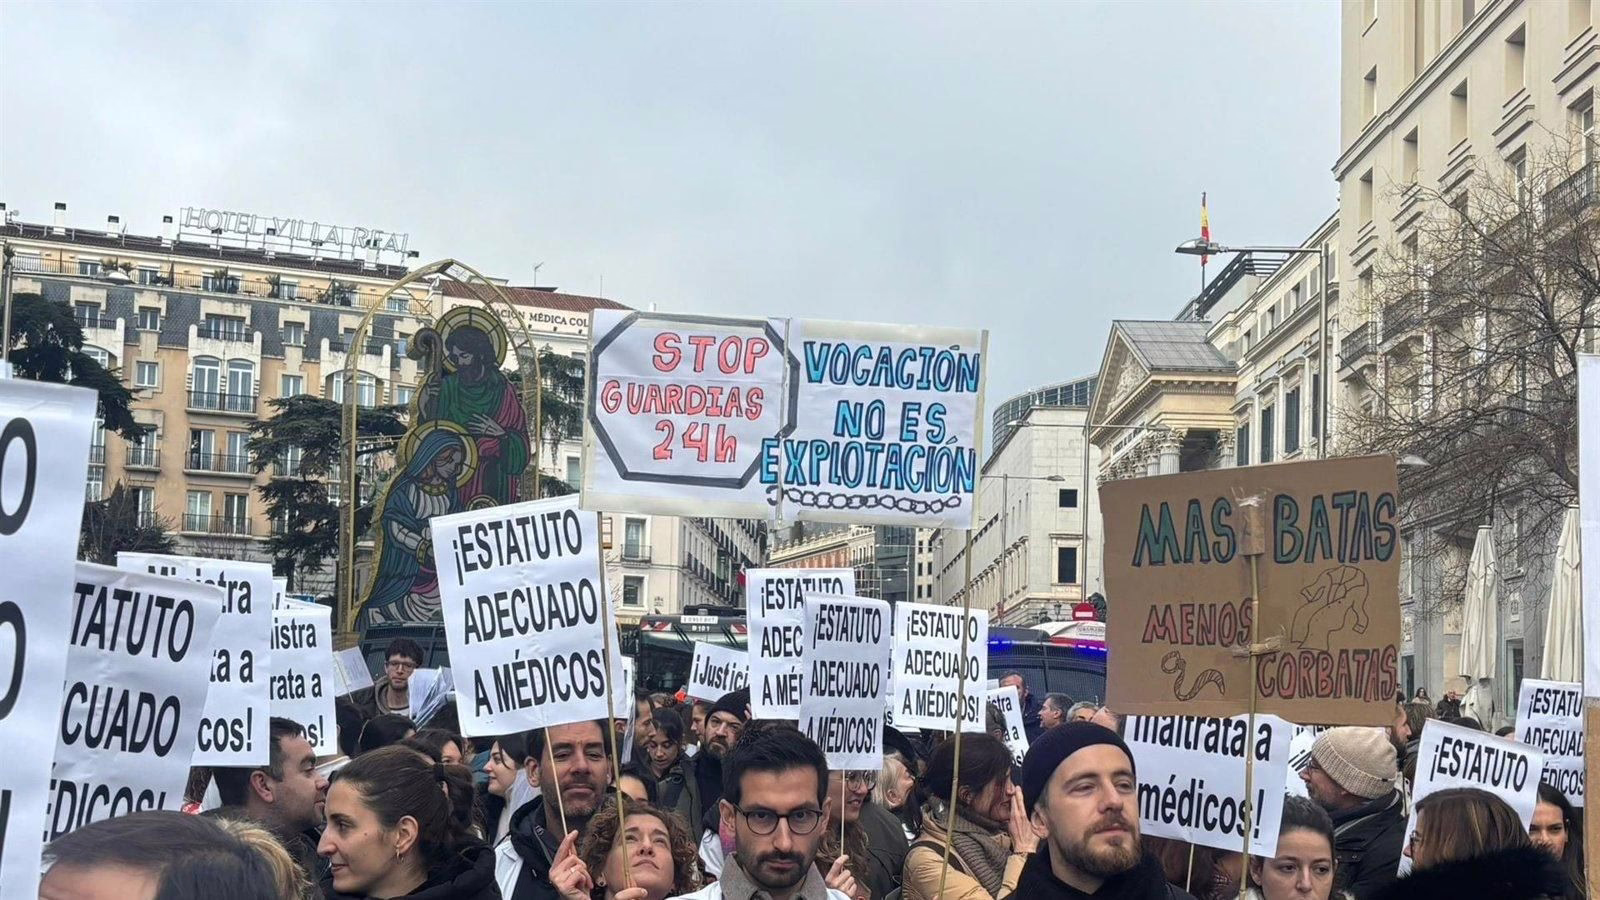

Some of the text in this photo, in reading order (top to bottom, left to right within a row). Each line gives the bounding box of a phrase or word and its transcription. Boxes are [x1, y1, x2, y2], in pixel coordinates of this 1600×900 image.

[185, 207, 263, 236] HOTEL
[273, 217, 340, 246] VILLA
[652, 332, 770, 375] STOP
[803, 342, 981, 393] VOCACIÓN
[600, 379, 765, 421] GUARDIAS
[834, 399, 947, 443] NO ES
[652, 419, 737, 463] 24h
[759, 436, 976, 494] EXPLOTACIÓN
[452, 508, 583, 586] ¡ESTATUTO
[1131, 490, 1397, 567] MAS BATAS
[464, 578, 598, 645] ADECUADO
[813, 603, 881, 650] ¡ESTATUTO
[1141, 598, 1252, 648] MENOS
[239, 649, 254, 683] a
[311, 673, 323, 698] a
[810, 659, 880, 699] ADECUADO
[904, 648, 980, 682] ADECUADO
[1256, 644, 1399, 703] CORBATAS
[474, 669, 494, 718] A
[762, 675, 774, 706] A
[902, 688, 913, 716] A
[915, 683, 980, 724] MÉDICOS!
[817, 707, 877, 754] MÉDICOS!
[1255, 723, 1272, 762] a
[1429, 736, 1529, 793] ¡ESTATUTO
[1137, 773, 1265, 839] médicos!
